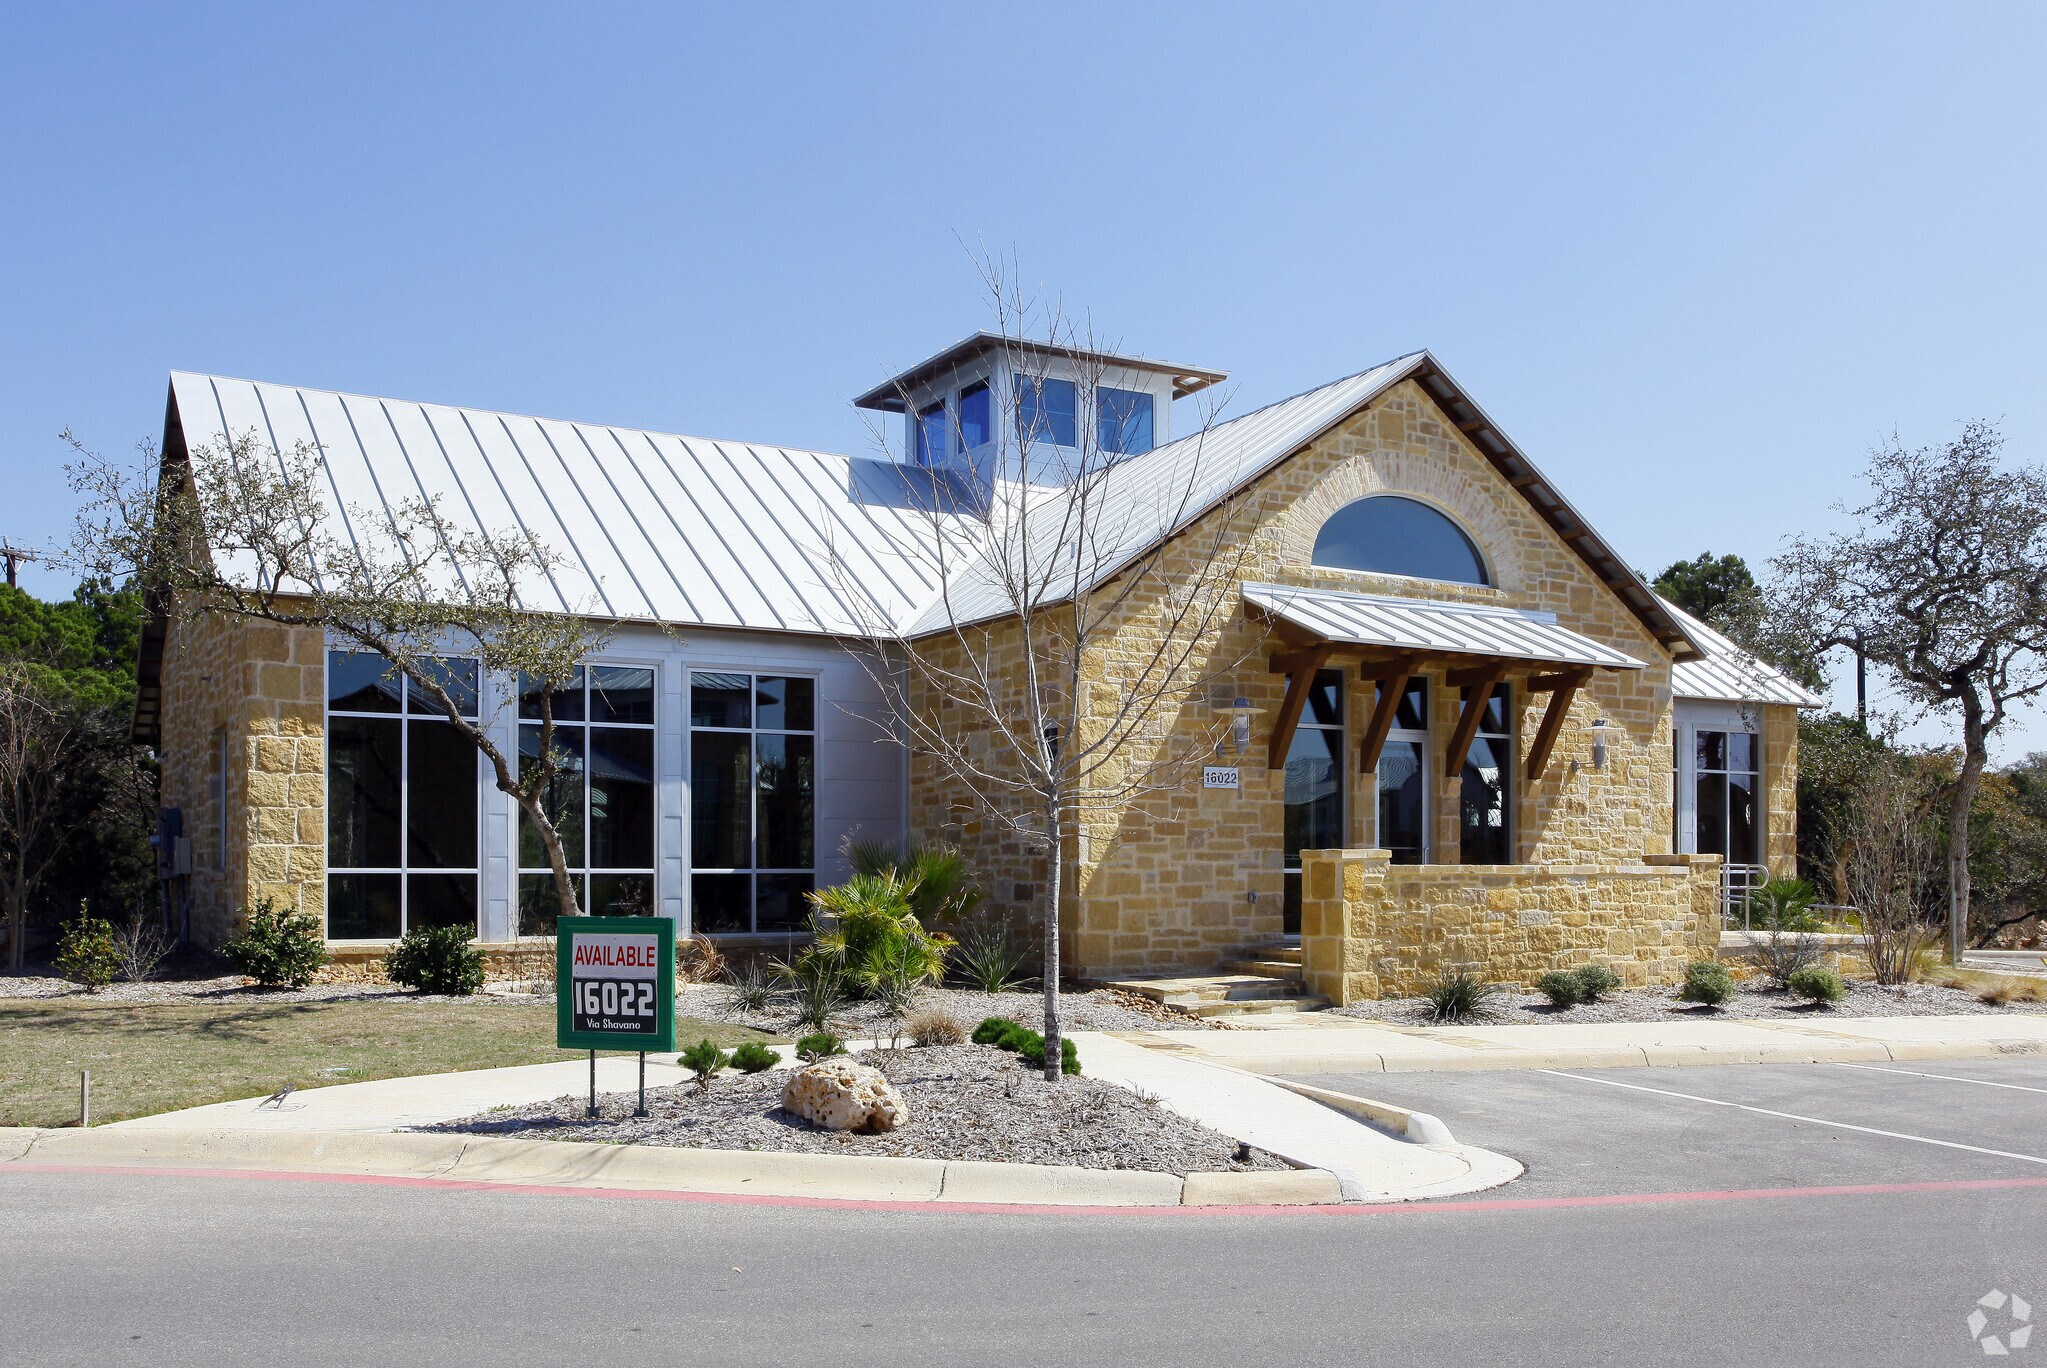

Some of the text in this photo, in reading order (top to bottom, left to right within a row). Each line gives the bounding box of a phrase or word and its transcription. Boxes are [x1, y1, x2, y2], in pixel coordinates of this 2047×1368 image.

[1205, 772, 1237, 783] 16022
[574, 945, 656, 967] AVAILABLE
[575, 981, 654, 1016] 16022
[586, 1018, 641, 1030] Via Shavano
